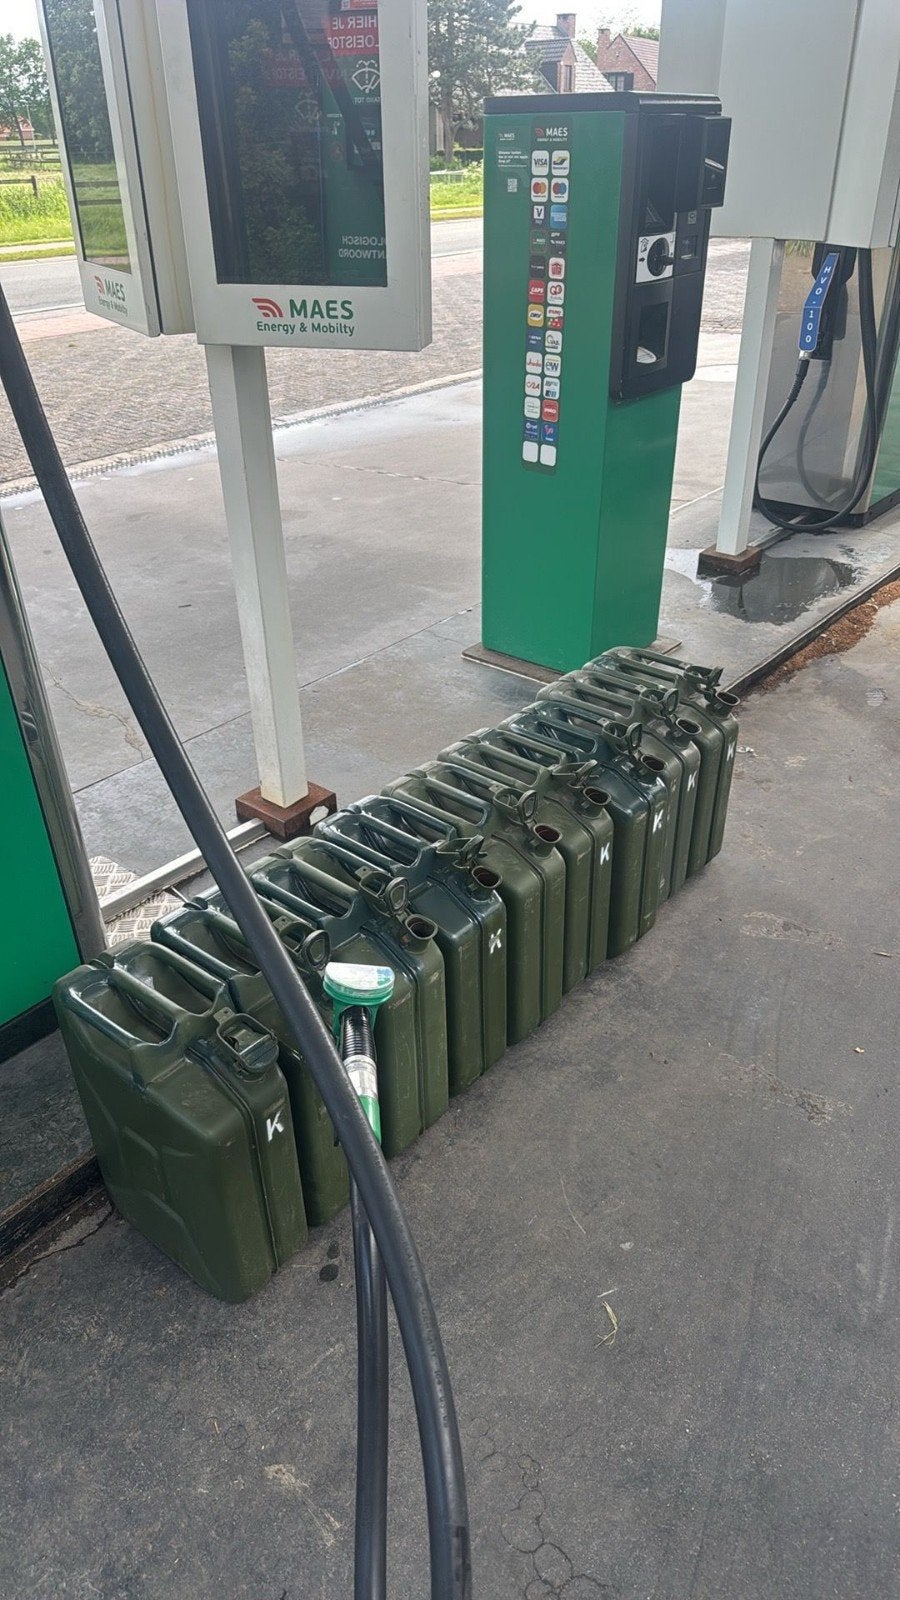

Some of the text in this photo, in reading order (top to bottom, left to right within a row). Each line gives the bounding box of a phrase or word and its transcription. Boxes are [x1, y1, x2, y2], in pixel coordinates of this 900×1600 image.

[546, 127, 568, 137] MAES
[534, 158, 547, 167] VISA
[104, 278, 126, 302] MAES
[289, 299, 354, 320] MAES
[256, 321, 355, 337] Energy & Mobilty
[687, 770, 698, 792] K
[599, 841, 611, 866] K
[489, 928, 502, 954] K
[266, 1110, 284, 1142] K
